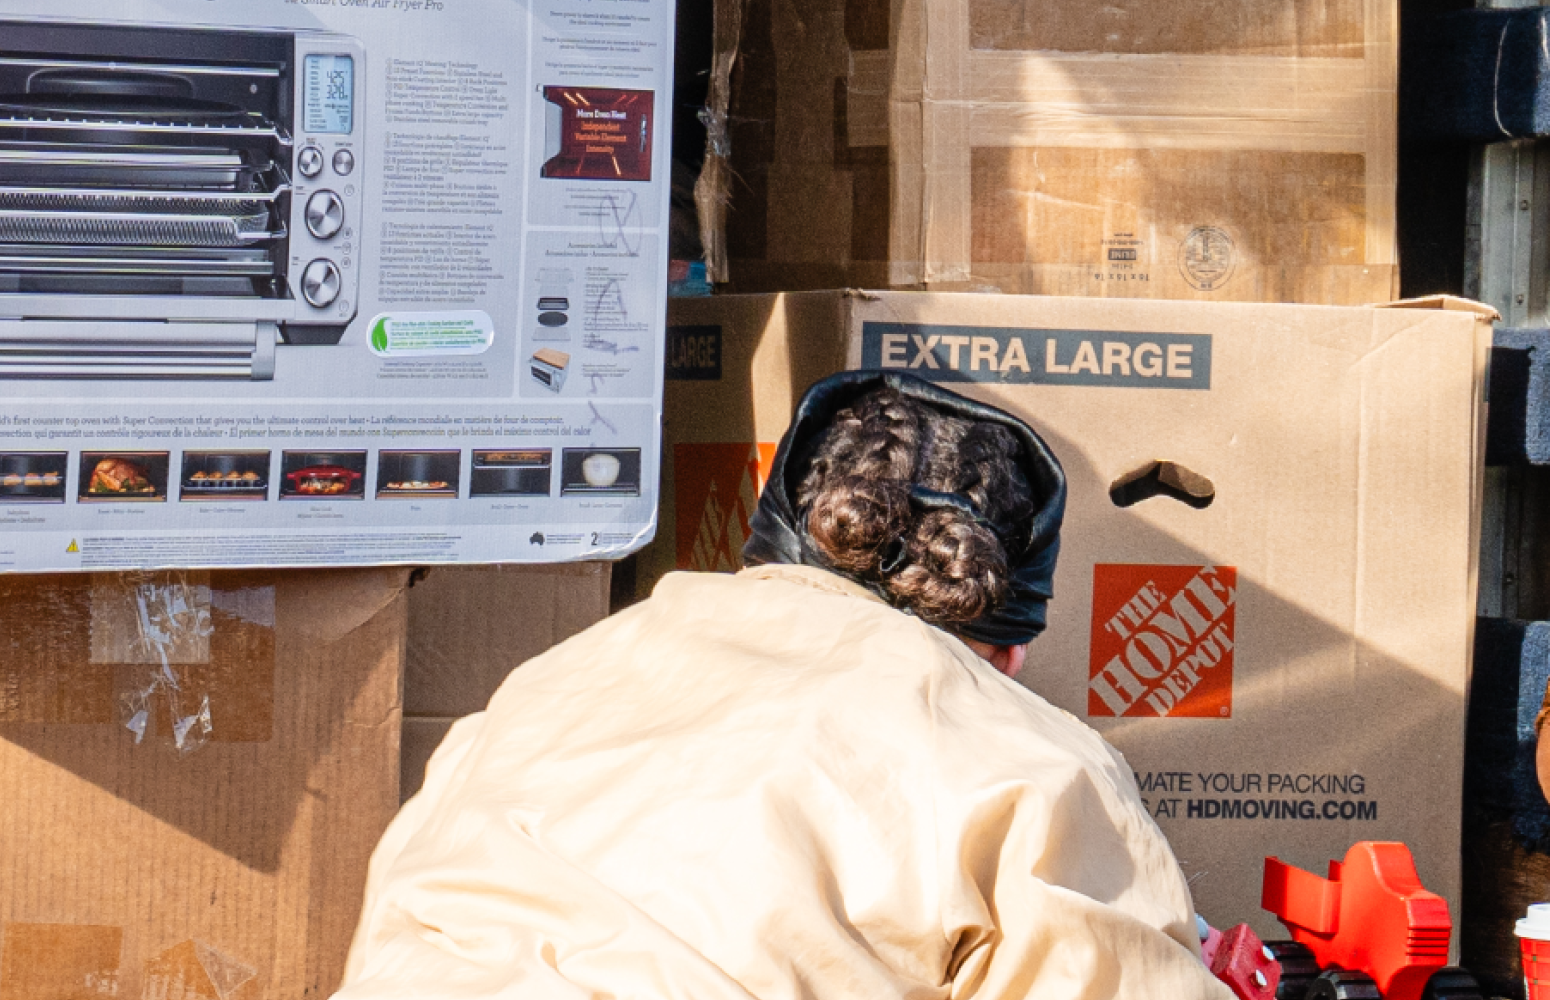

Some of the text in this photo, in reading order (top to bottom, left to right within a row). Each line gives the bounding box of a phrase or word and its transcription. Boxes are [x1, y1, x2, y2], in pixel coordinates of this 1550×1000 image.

[390, 0, 423, 11] Fryer
[424, 0, 444, 11] Pro
[671, 334, 716, 368] LARGE
[881, 333, 1194, 378] EXTRA LARGE
[1104, 579, 1168, 641] THE
[1087, 566, 1237, 717] HOME
[1145, 622, 1235, 717] DEPOT
[1198, 773, 1262, 793] YOUR
[1267, 774, 1366, 794] PACKING
[1155, 798, 1378, 820] AT HDMOVING.COM
